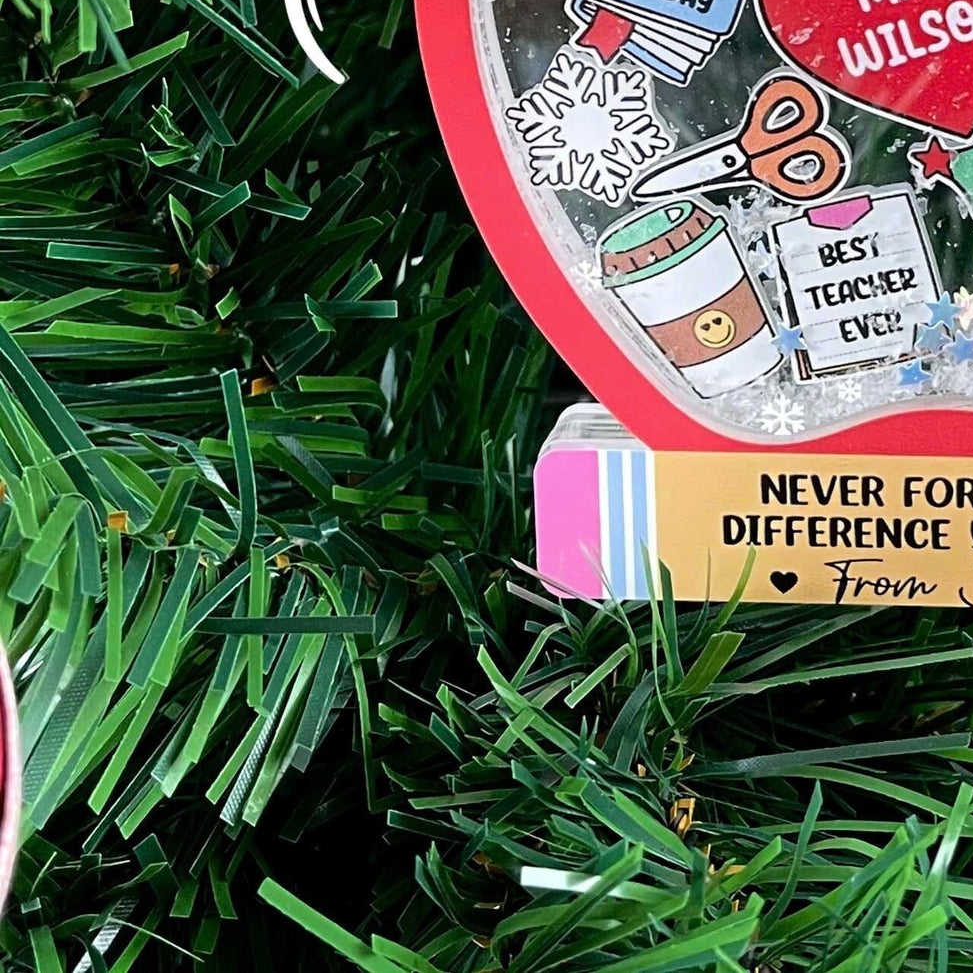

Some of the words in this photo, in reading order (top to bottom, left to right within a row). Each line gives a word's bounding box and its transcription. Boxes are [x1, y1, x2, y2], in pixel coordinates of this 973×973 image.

[804, 267, 918, 310] TEACHER
[838, 308, 904, 343] EVER
[760, 473, 885, 507] NEVER
[722, 514, 951, 550] DIFFERENCE
[824, 558, 938, 605] From
